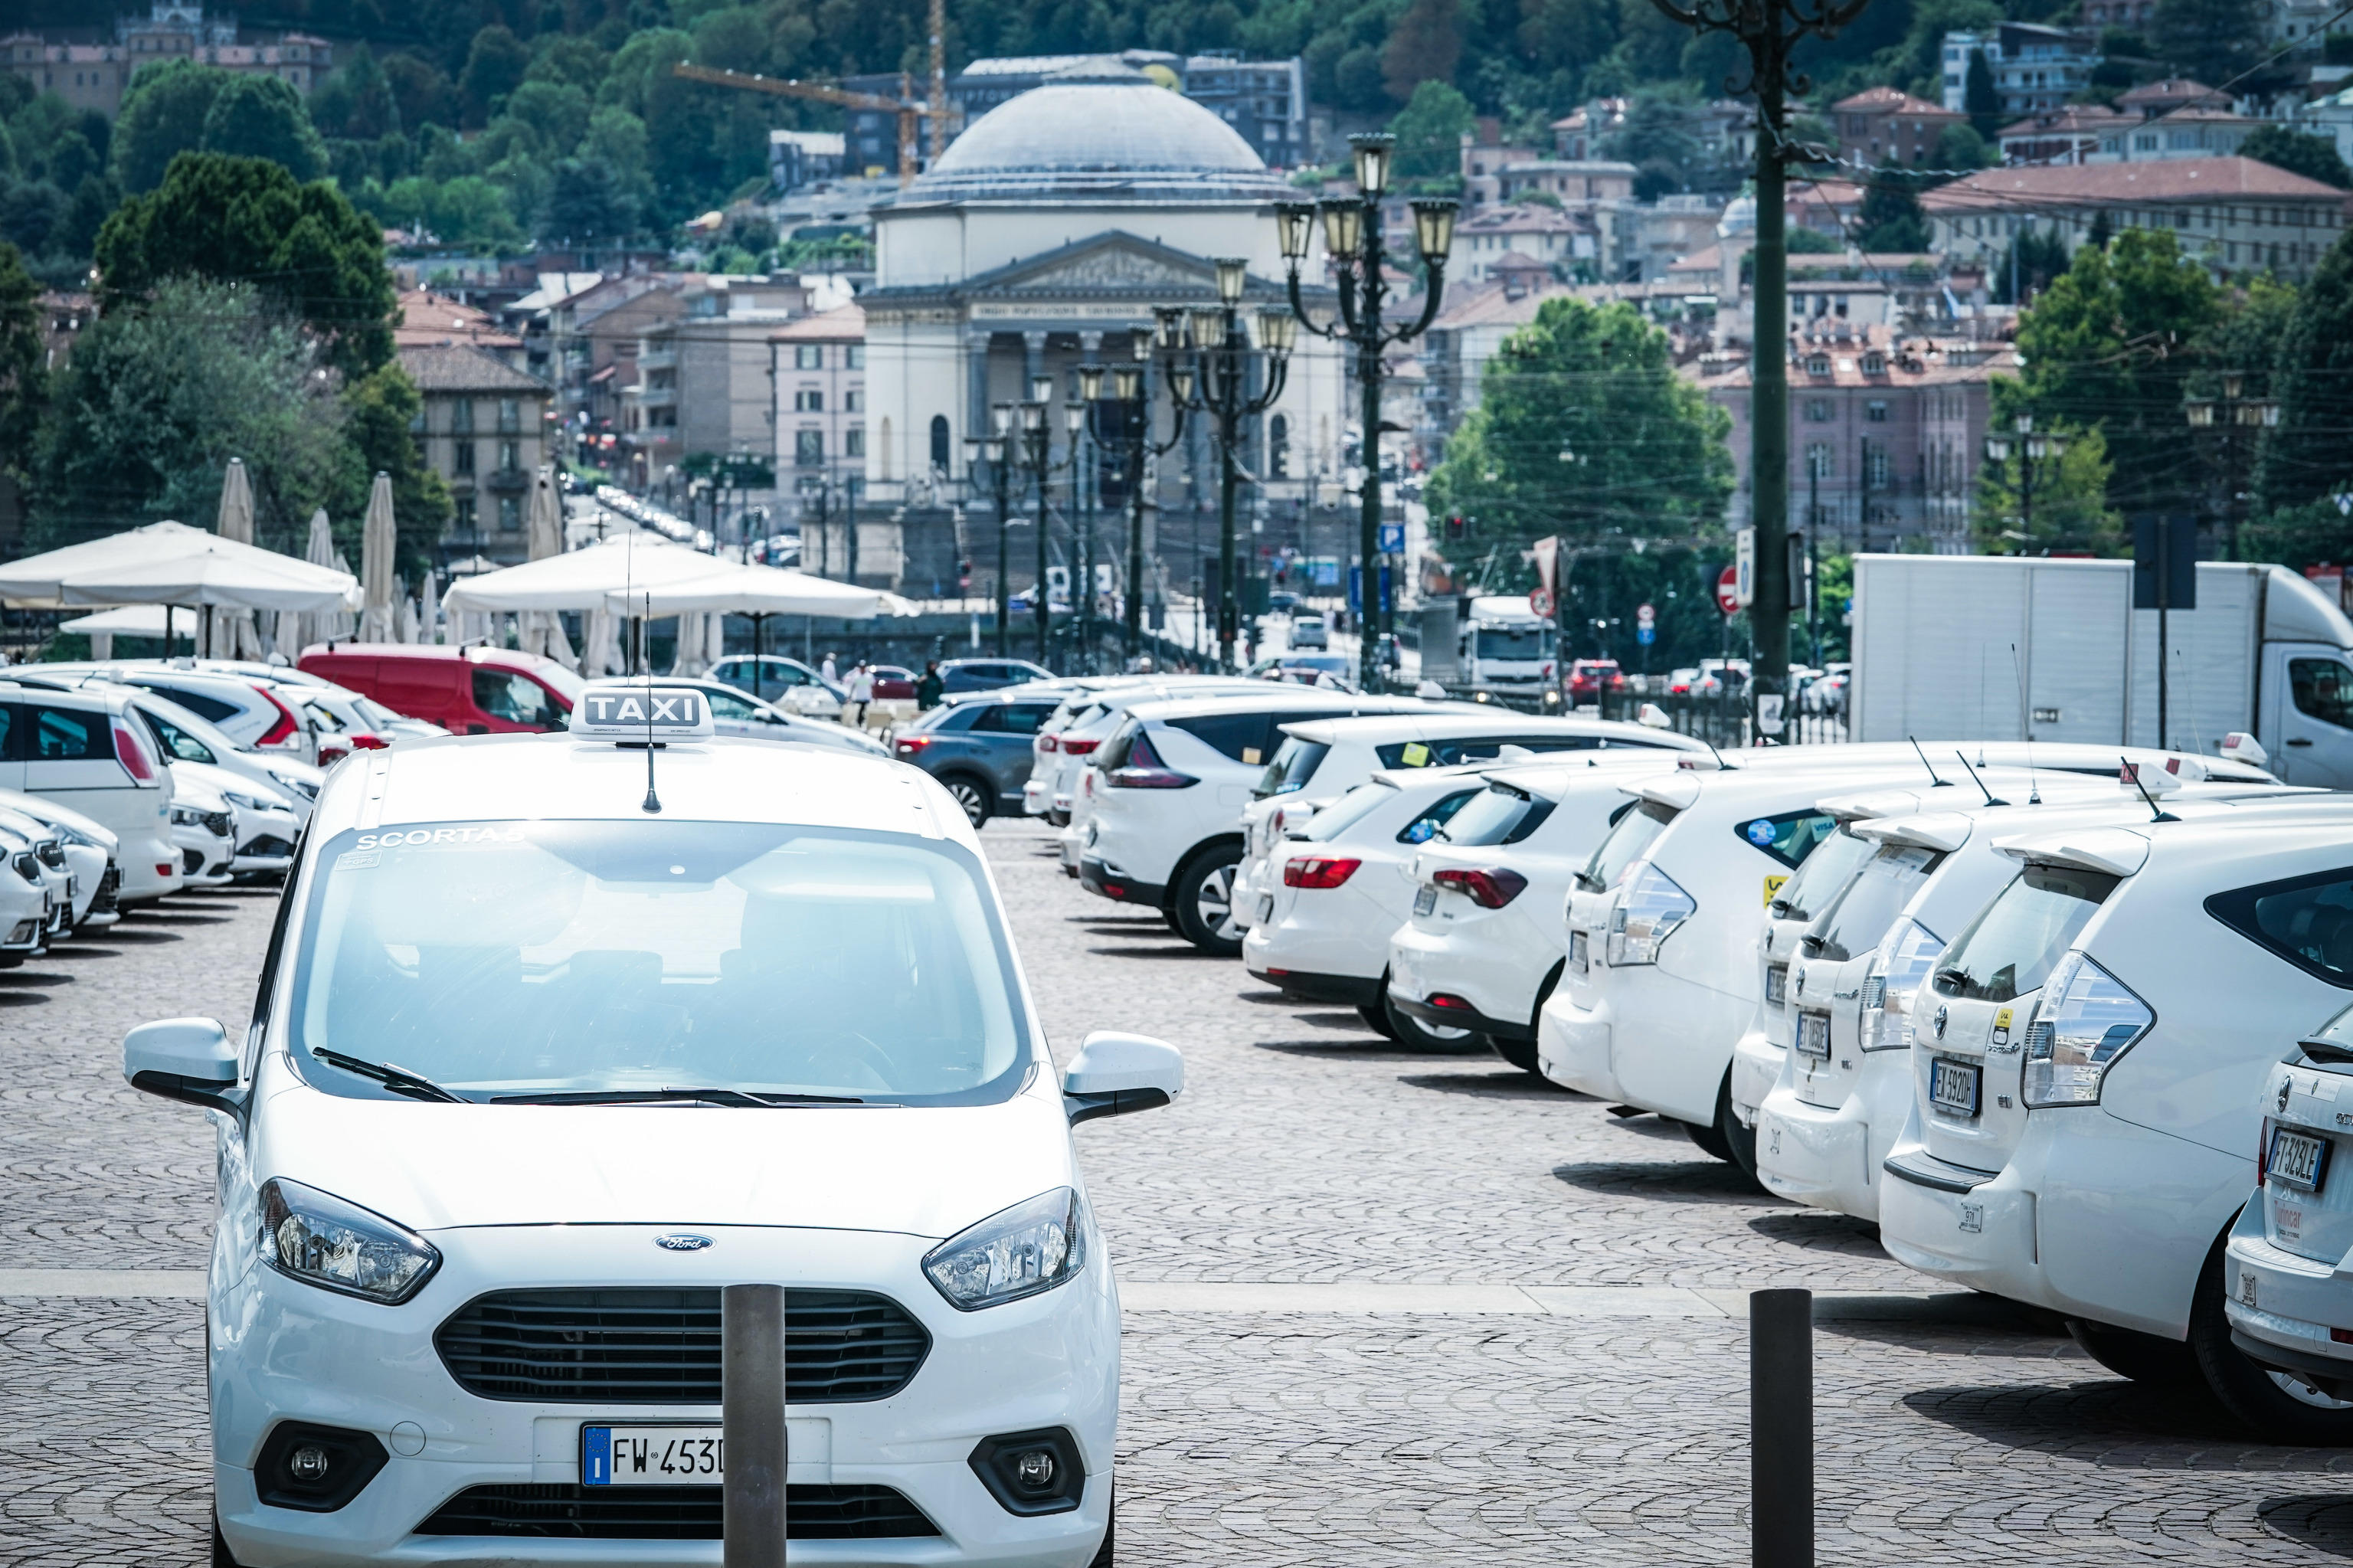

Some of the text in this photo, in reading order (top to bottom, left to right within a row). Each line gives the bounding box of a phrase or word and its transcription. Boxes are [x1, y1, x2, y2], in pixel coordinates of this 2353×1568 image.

[1385, 528, 1399, 546] P
[587, 697, 693, 722] TAXI
[356, 827, 500, 850] SCORTA
[1815, 822, 1834, 832] VISA
[1936, 1066, 1972, 1105] EX 592DH
[2285, 1138, 2318, 1180] 323LE
[2274, 1200, 2302, 1229] Turincar
[667, 1237, 702, 1249] Ford
[614, 1439, 648, 1473] FW
